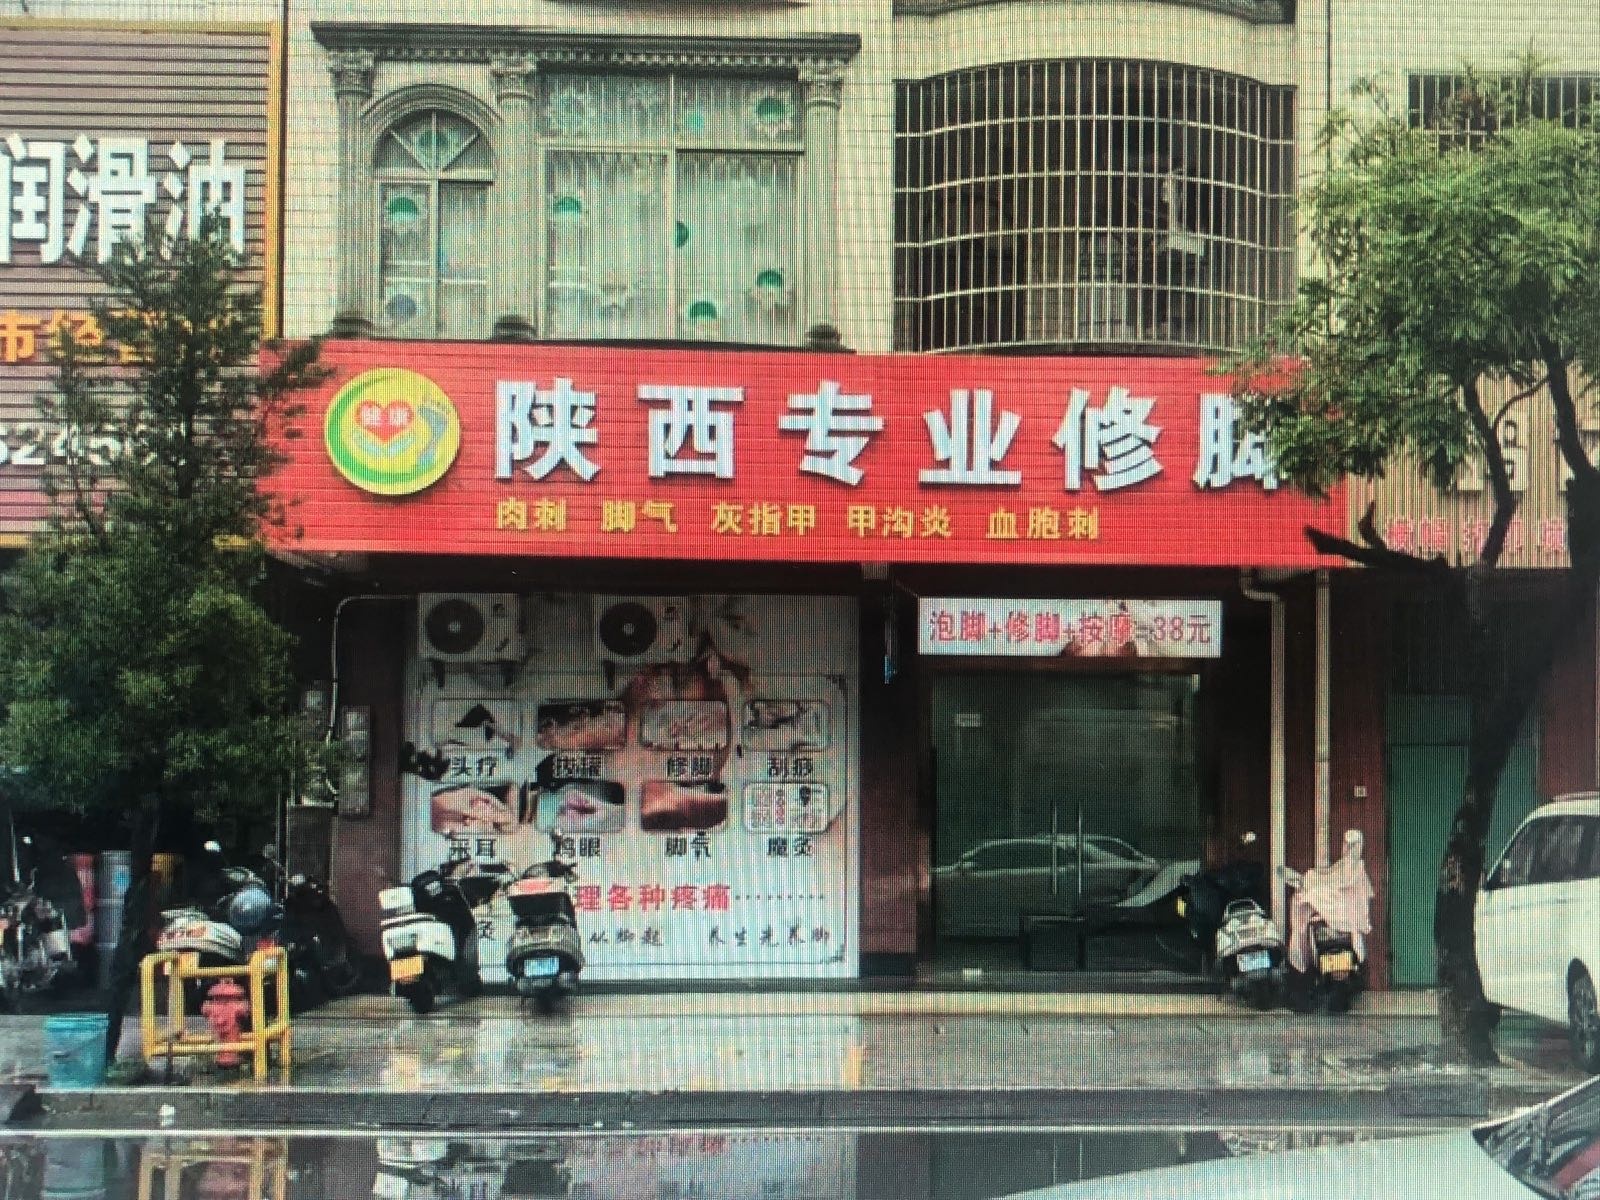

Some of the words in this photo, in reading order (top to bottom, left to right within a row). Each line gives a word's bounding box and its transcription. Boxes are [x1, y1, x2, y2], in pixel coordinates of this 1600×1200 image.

[495, 499, 567, 533] 肉刺
[601, 500, 677, 534] 脚气
[711, 501, 817, 536] 灰指甲
[847, 505, 954, 540] 甲沟炎
[986, 506, 1101, 541] 血胞刺
[929, 610, 1211, 646] 泡脚+修脚+按摩=38元
[667, 757, 713, 777] 修脚
